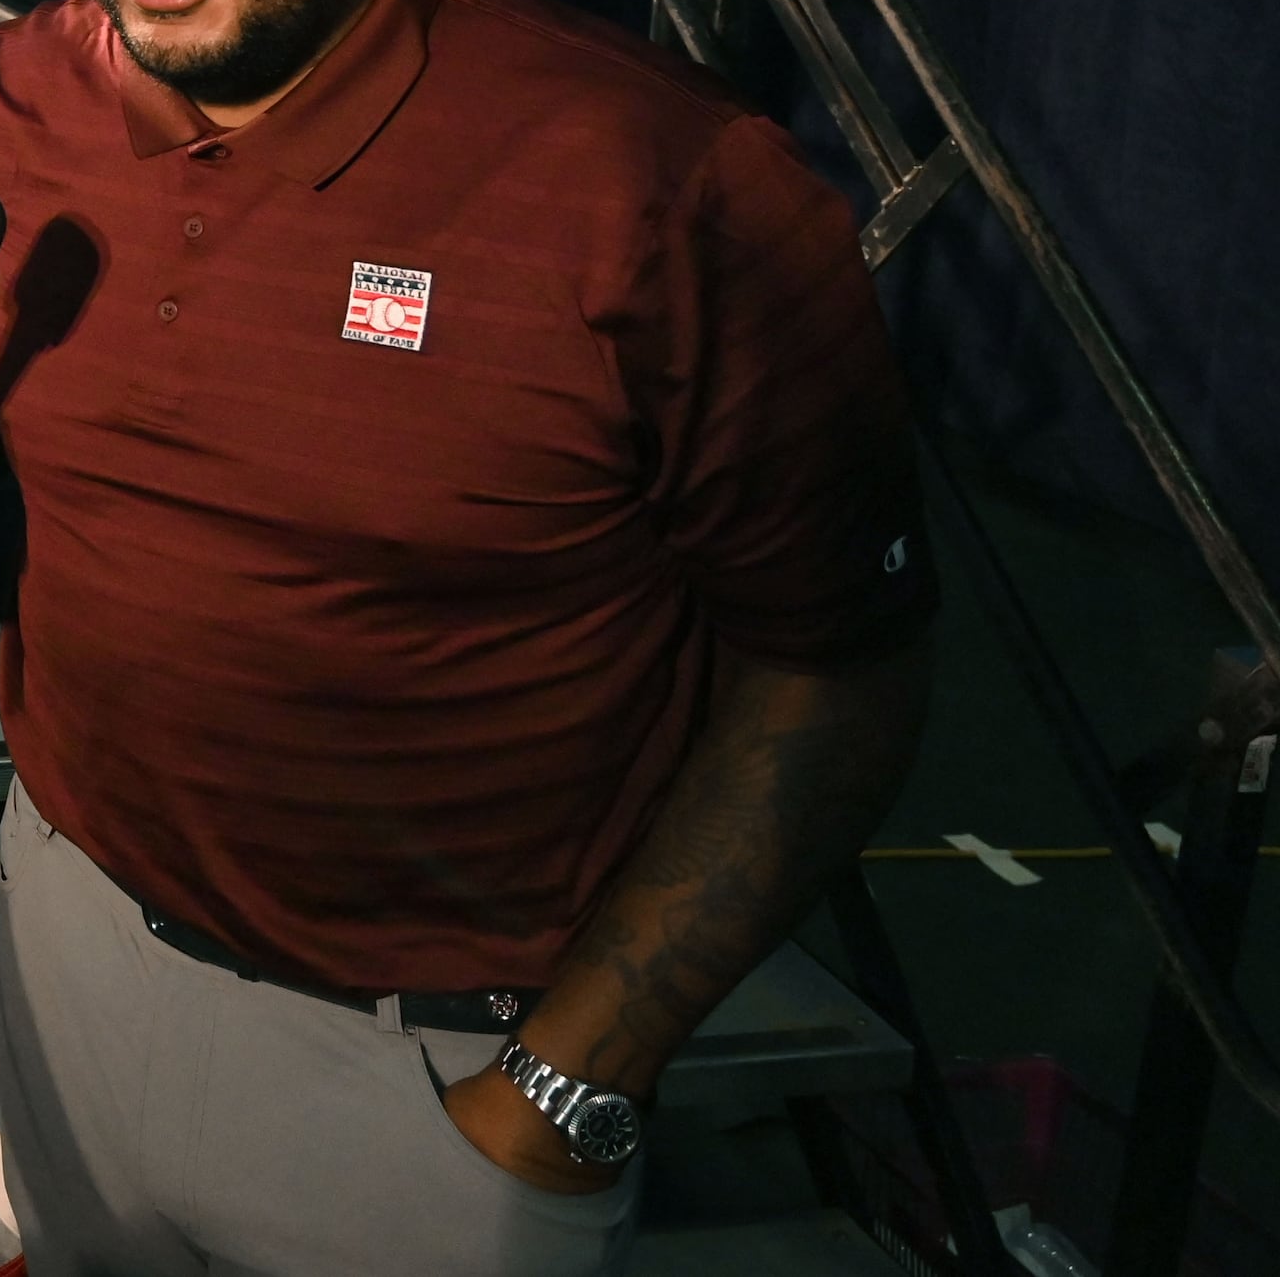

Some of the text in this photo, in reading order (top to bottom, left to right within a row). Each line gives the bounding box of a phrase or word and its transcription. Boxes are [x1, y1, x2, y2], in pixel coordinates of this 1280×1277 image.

[358, 264, 425, 281] NATIONAL
[355, 282, 423, 299] BASEBALL
[344, 329, 415, 348] HALL OF FAME
